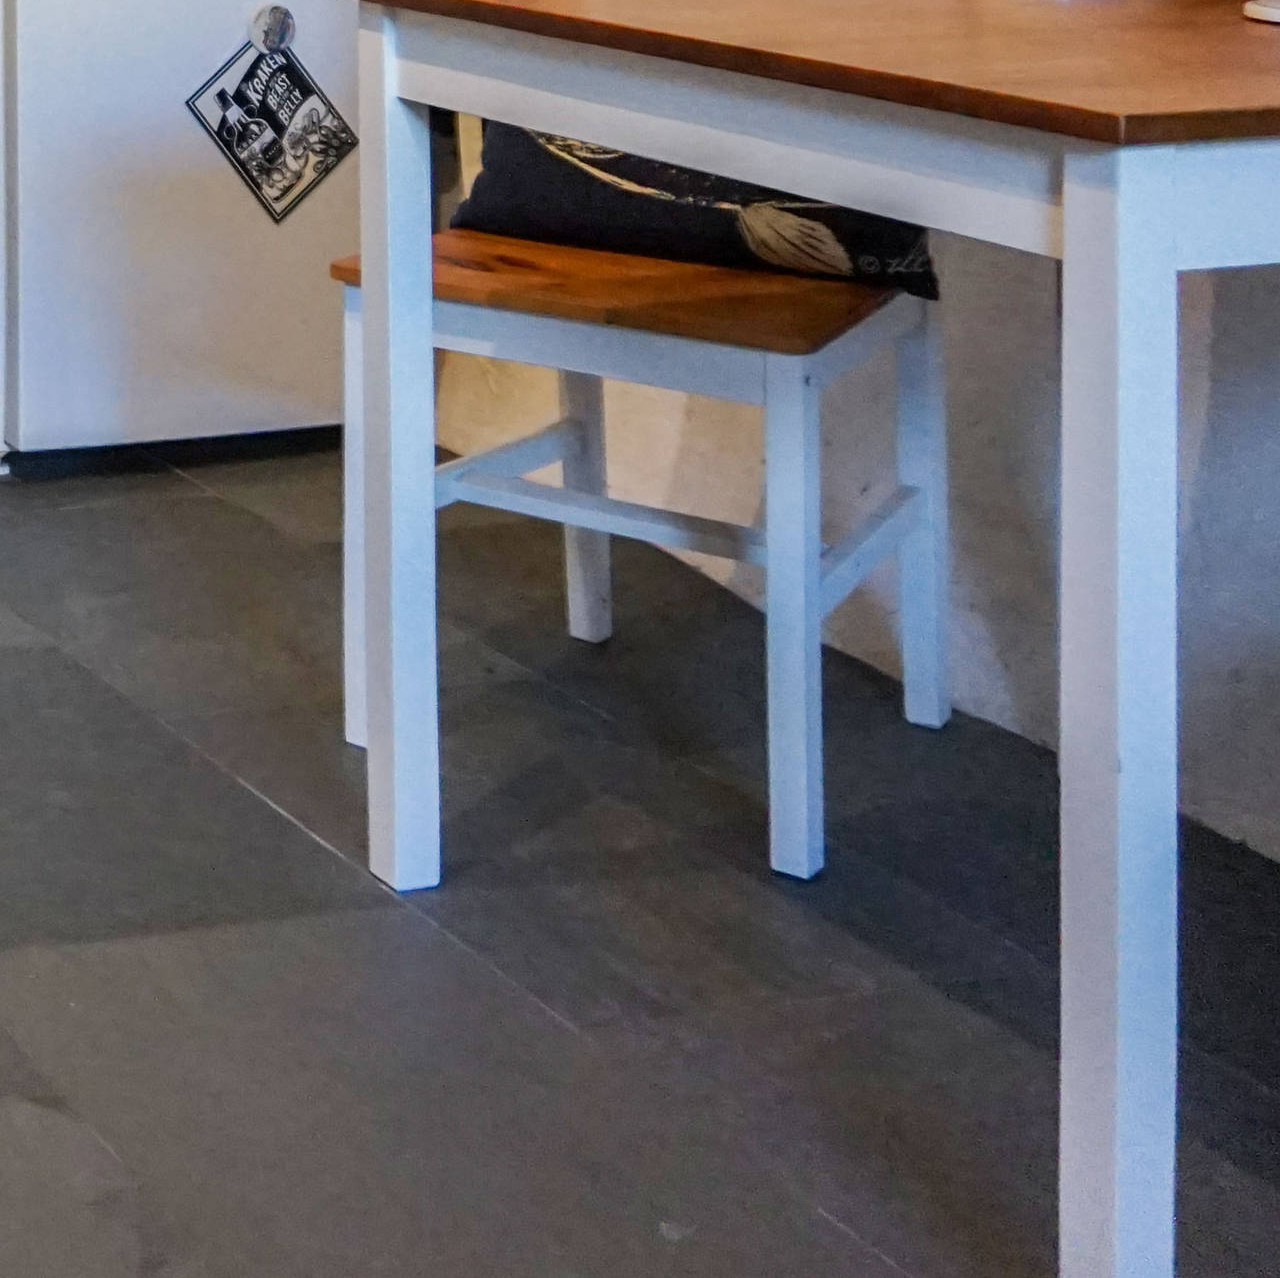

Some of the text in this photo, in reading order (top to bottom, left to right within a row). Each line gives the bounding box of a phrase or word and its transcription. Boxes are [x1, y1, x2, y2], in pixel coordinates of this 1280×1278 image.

[247, 52, 287, 108] KRAKEN
[268, 73, 291, 110] BEAST
[279, 88, 303, 126] BELLY
